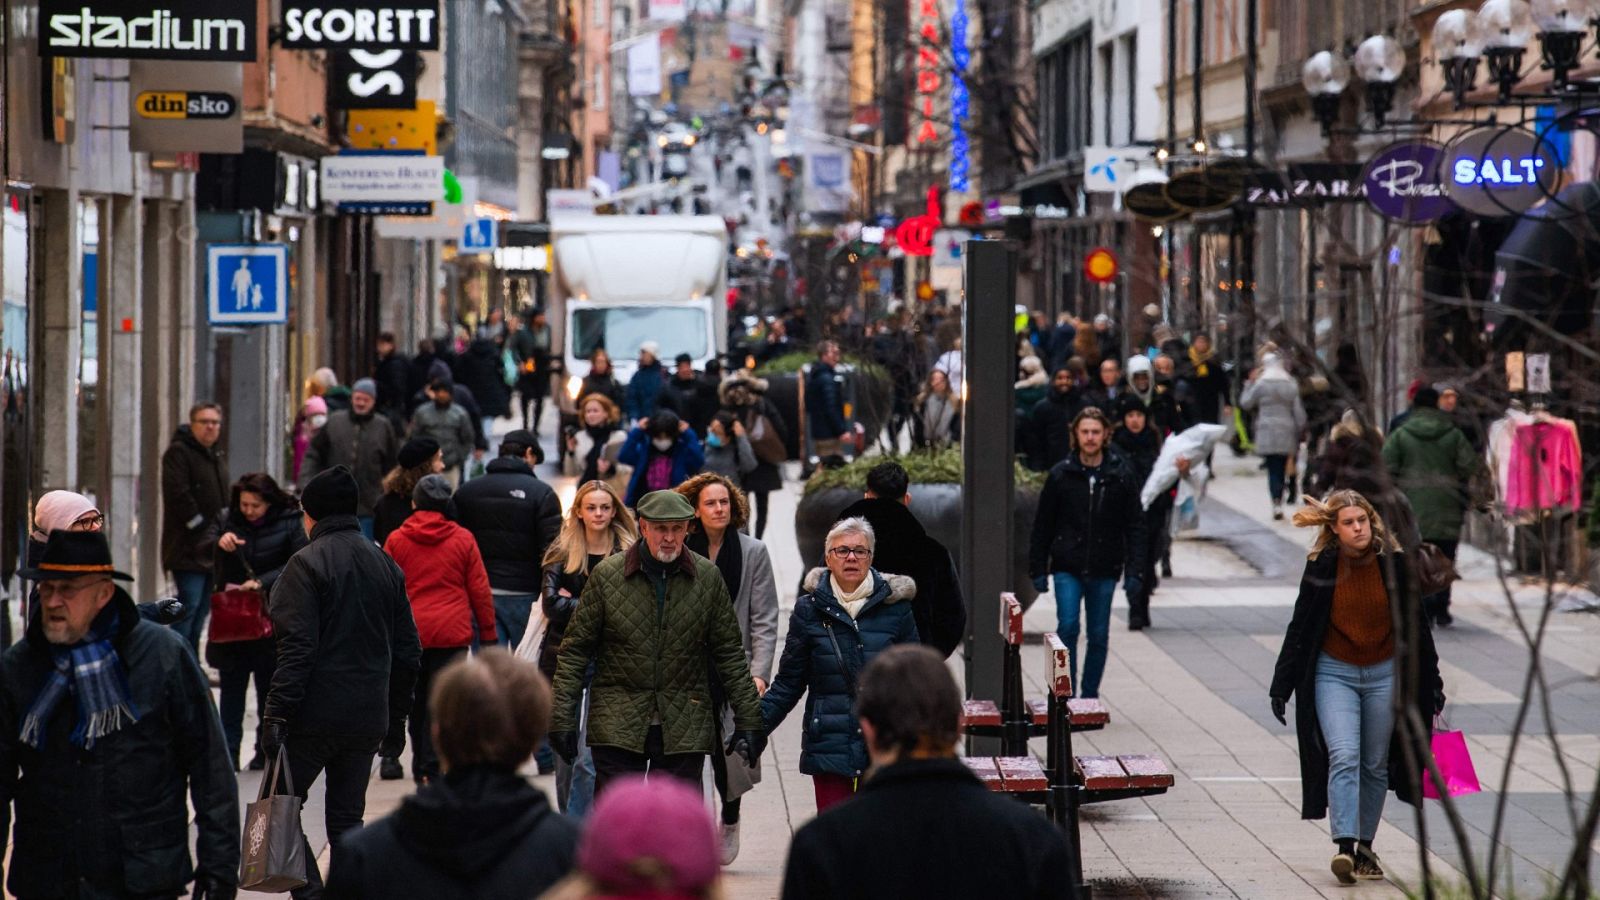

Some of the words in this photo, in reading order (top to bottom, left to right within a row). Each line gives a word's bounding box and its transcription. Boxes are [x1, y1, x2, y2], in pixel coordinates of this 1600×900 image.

[49, 7, 245, 51] stadium
[285, 8, 435, 42] SCORETT
[1454, 159, 1544, 184] SALT
